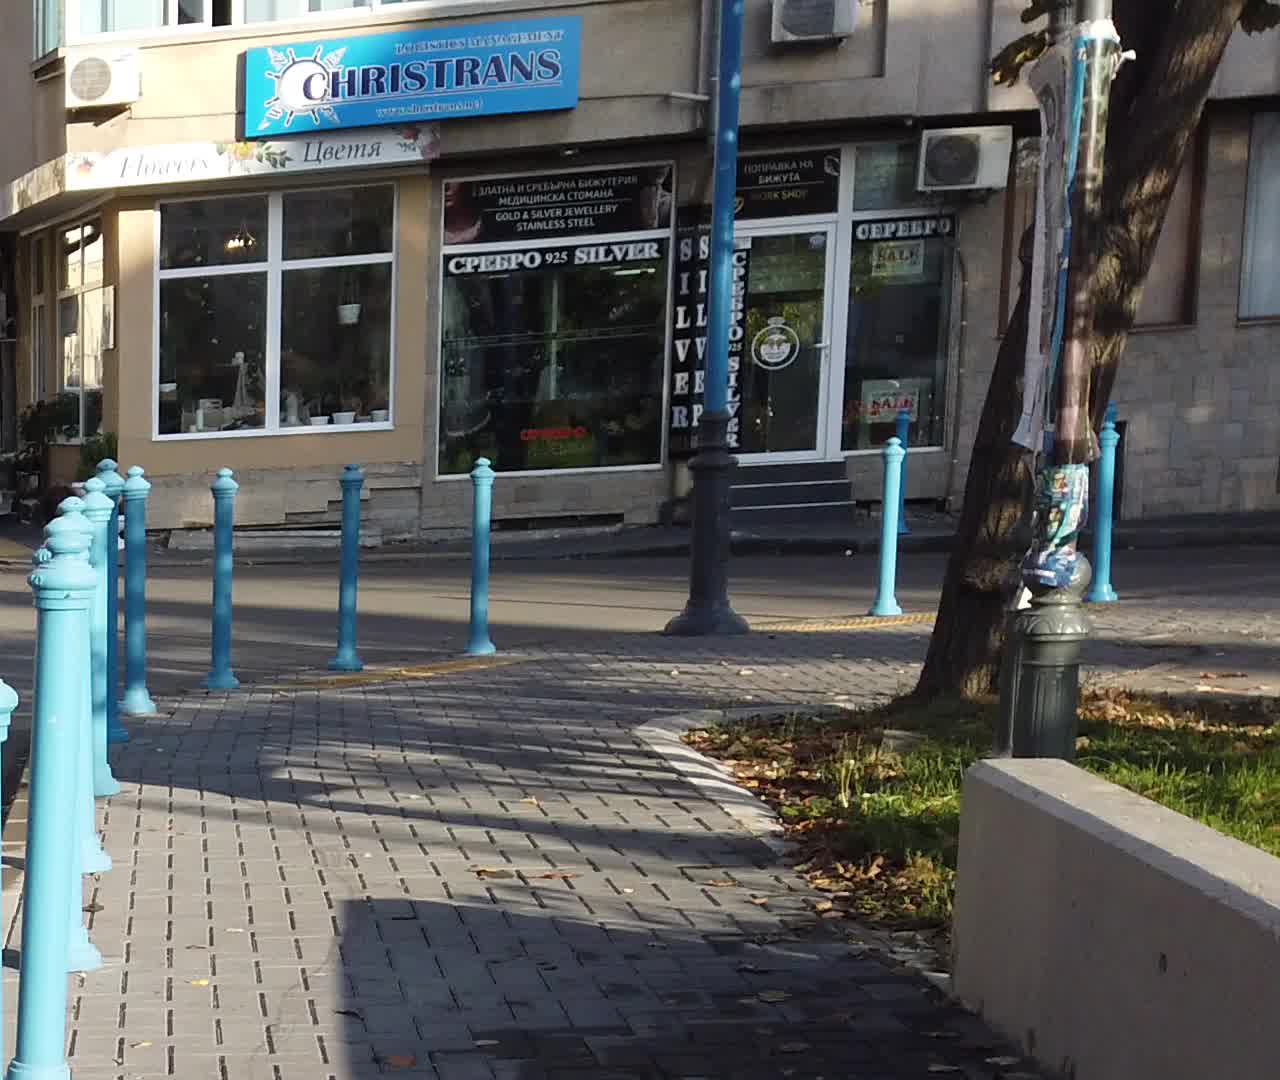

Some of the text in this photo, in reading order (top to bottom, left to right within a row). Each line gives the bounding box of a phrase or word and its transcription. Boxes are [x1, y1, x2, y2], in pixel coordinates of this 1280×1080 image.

[302, 49, 562, 101] CHRISTRANS
[303, 139, 383, 164] Цветя
[567, 189, 614, 201] СТОМАНА
[495, 204, 618, 221] GOLD & SILVER JEWELLERY
[516, 216, 595, 231] STAINLESS STEEL
[855, 218, 951, 240] СЕРЕБРО
[448, 241, 660, 275] СРЕБРО 925 SILVER
